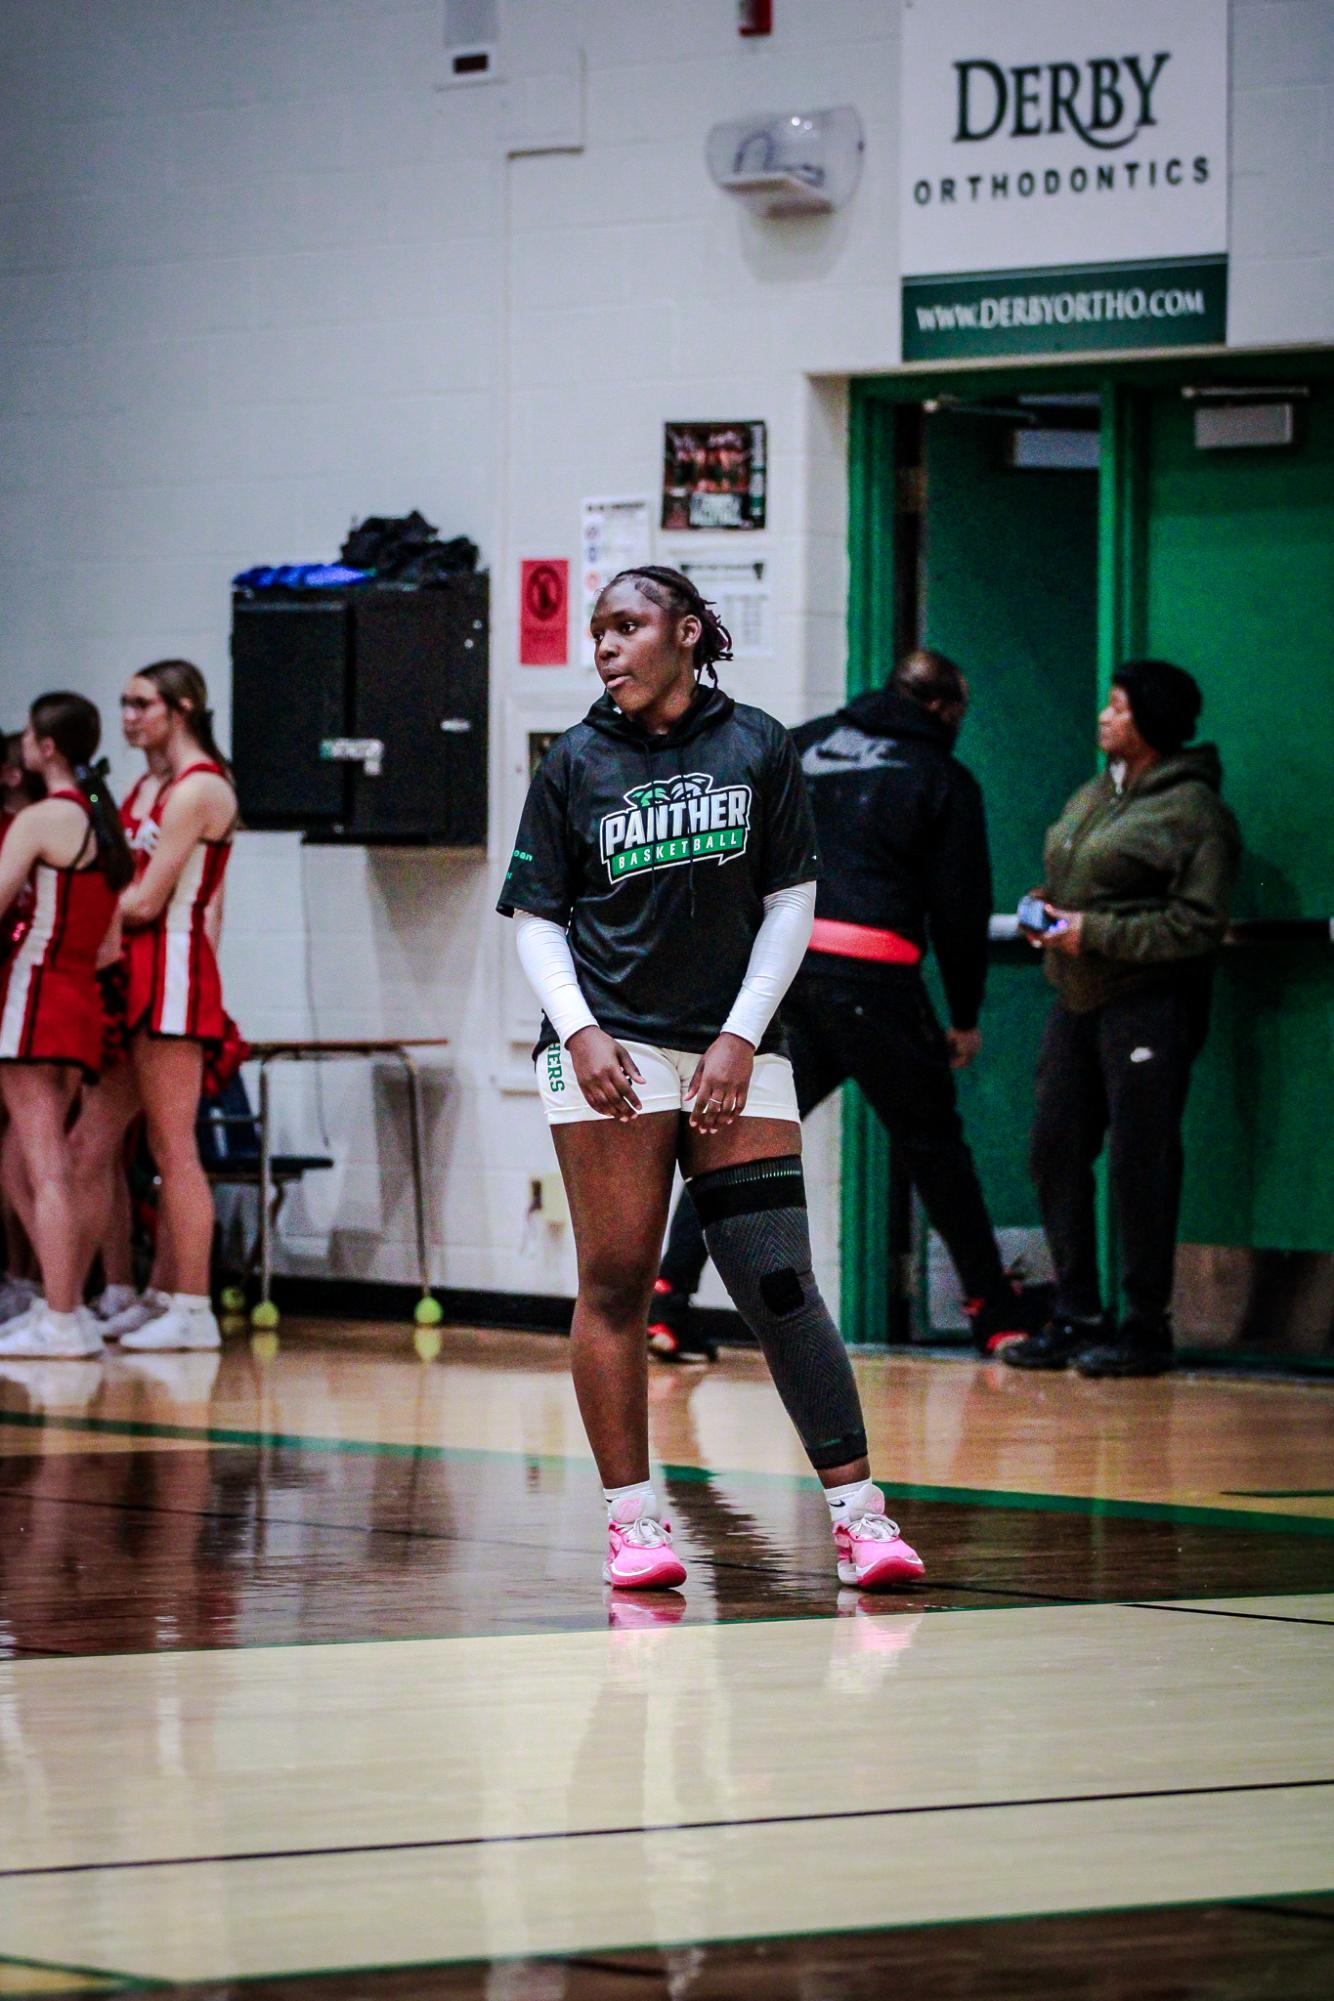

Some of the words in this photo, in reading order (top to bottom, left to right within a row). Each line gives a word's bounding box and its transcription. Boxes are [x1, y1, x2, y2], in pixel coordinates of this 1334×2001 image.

[952, 52, 1171, 150] DERBY
[914, 156, 1210, 206] ORTHODONTICS
[605, 790, 746, 857] PANTHER
[618, 832, 737, 870] BASKETBALL
